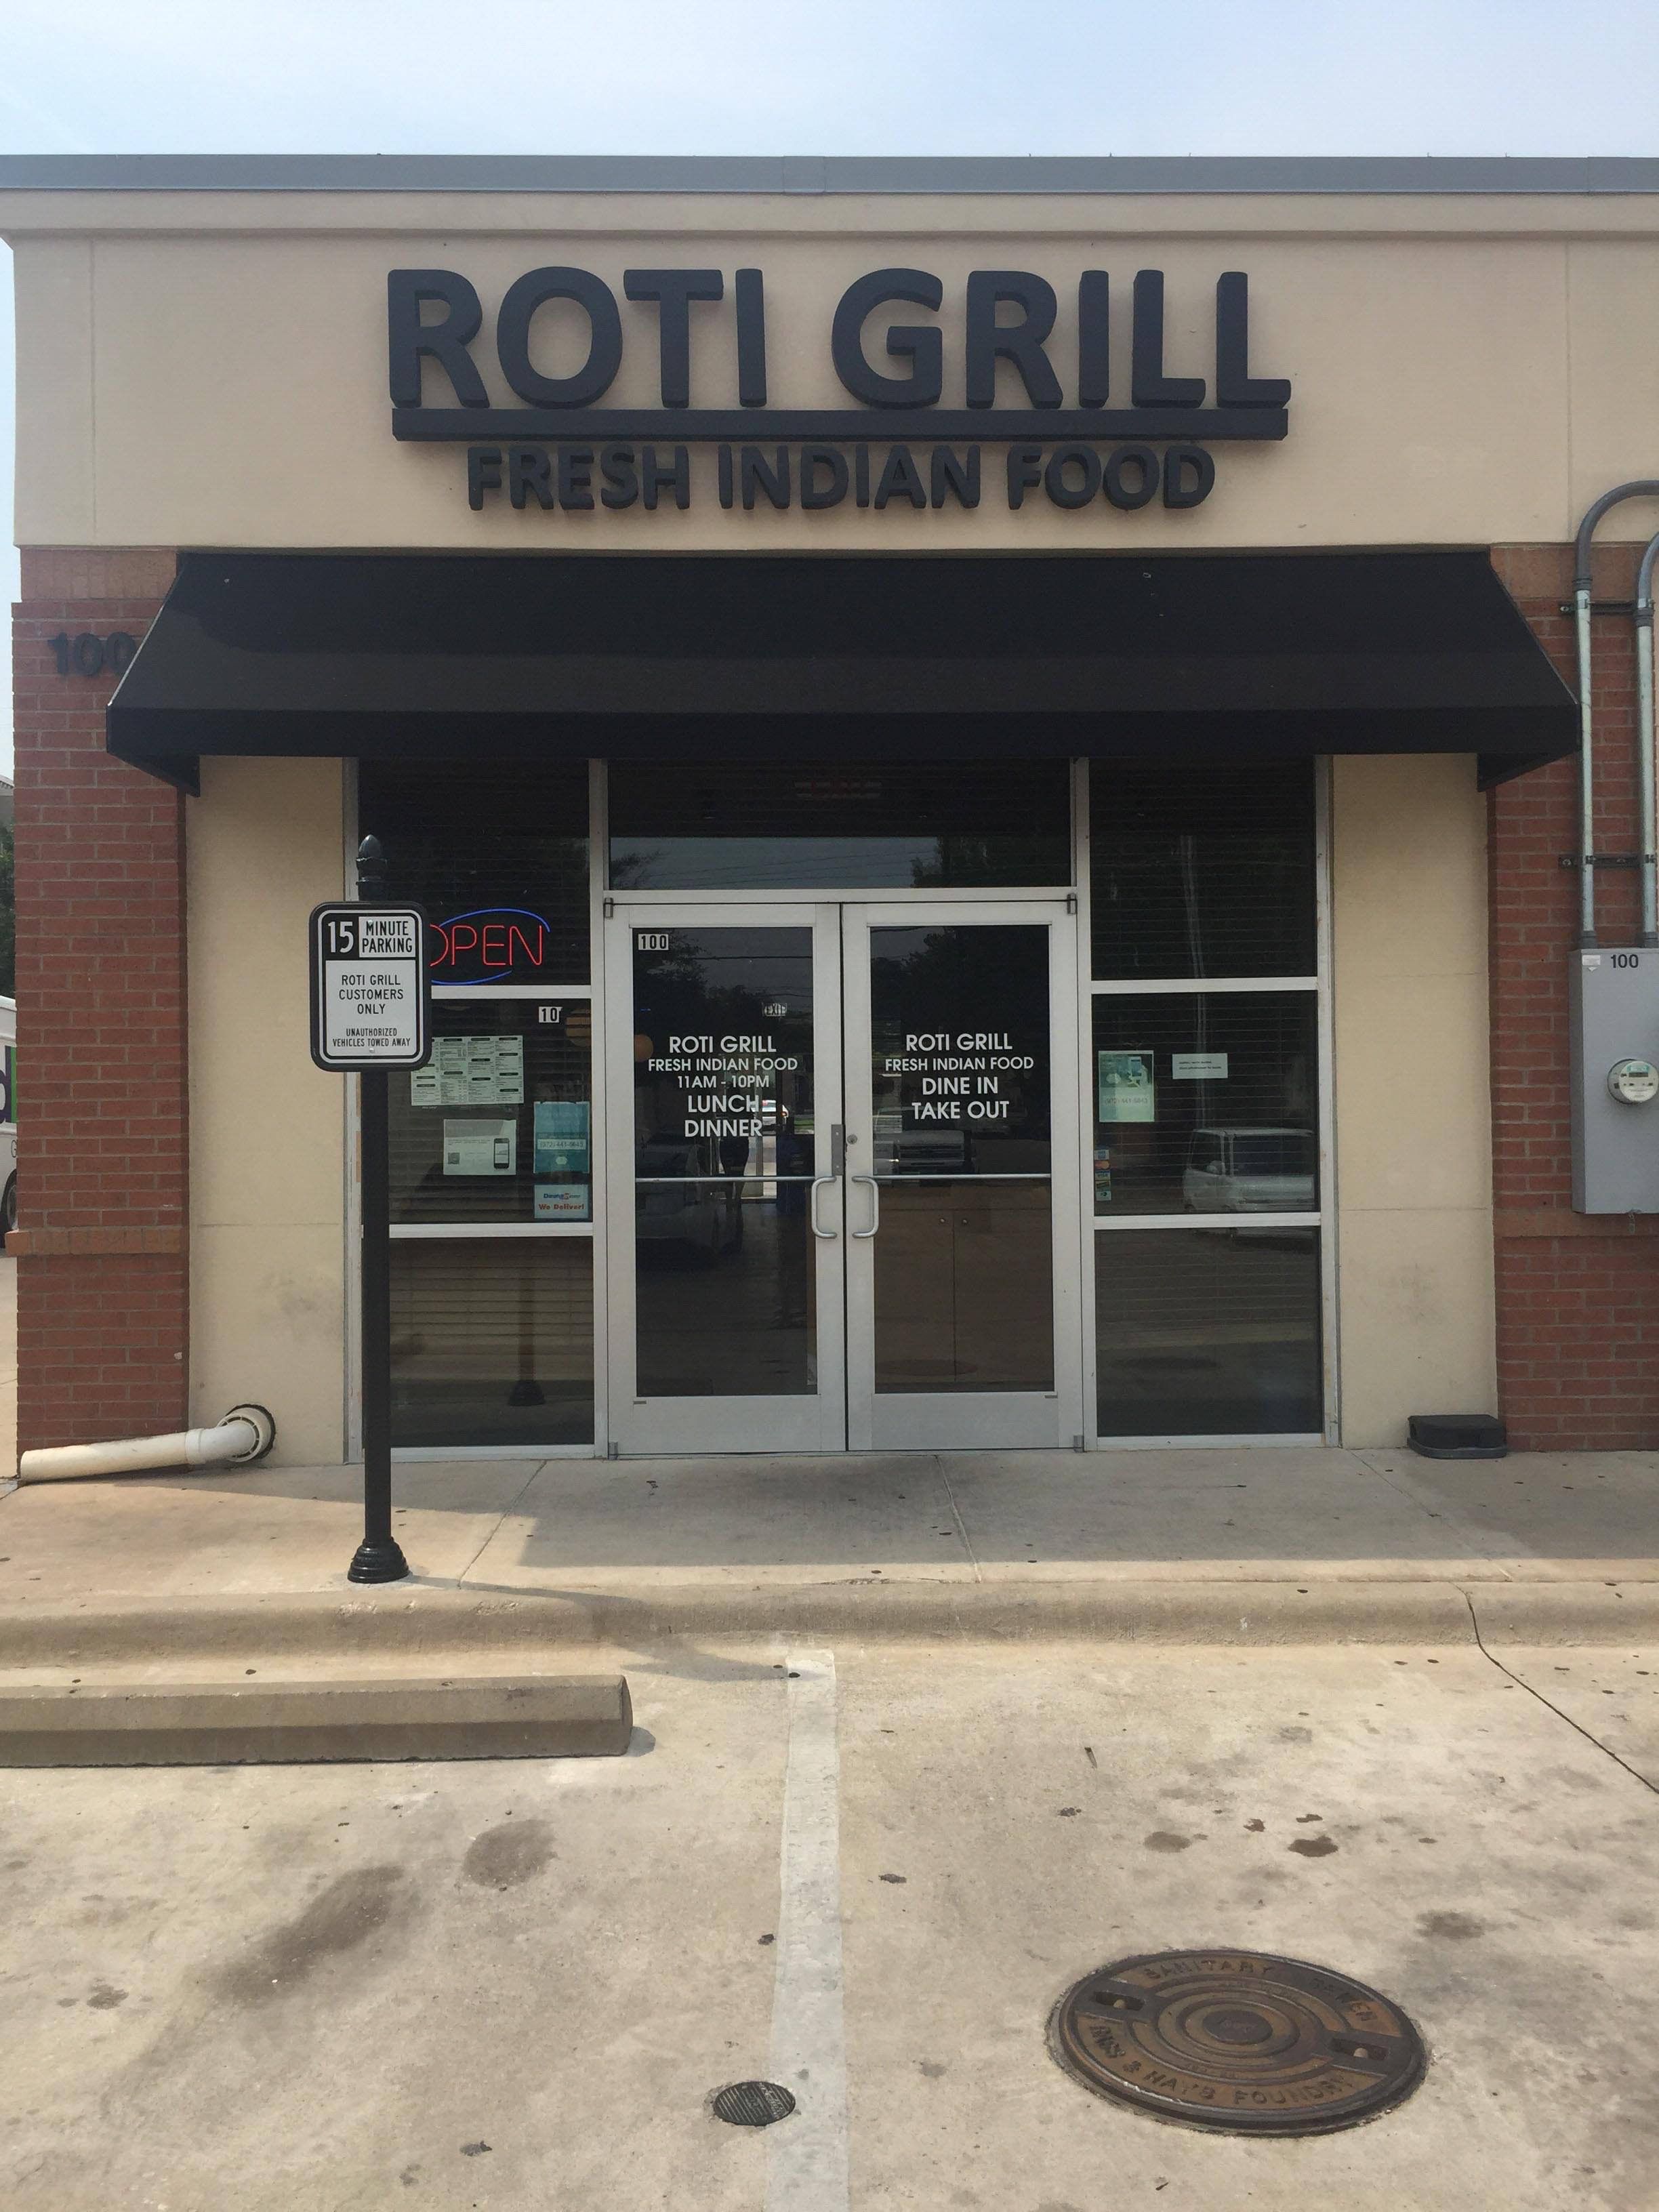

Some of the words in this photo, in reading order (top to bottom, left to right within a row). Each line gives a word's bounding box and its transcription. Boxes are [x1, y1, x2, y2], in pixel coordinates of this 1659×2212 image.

[387, 266, 768, 409] ROTI
[831, 268, 1291, 409] GRILL
[468, 444, 690, 512] FRESH
[718, 443, 981, 511] INDIAN
[1007, 444, 1217, 512] FOOD
[47, 632, 136, 676] 100
[366, 920, 409, 936] MINUTE
[328, 921, 354, 954] 15
[362, 937, 413, 954] PARKING
[641, 935, 667, 949] 100
[1610, 954, 1639, 968] 100
[342, 975, 365, 986] ROTI
[370, 975, 401, 985] GRILL
[339, 989, 404, 1000] CUSTOMERS
[357, 1004, 386, 1015] ONLY
[346, 1027, 397, 1037] UNAUTHORIZED
[333, 1038, 365, 1047] VEHICLES
[367, 1038, 390, 1047] TOWED
[392, 1038, 411, 1047] AWAY
[669, 1036, 714, 1053] ROTI
[720, 1035, 777, 1053] GRILL
[906, 1033, 949, 1051] ROTI
[956, 1033, 1013, 1051] GRILL
[648, 1058, 691, 1072] FRESH
[696, 1058, 750, 1071] INDIAN
[754, 1057, 798, 1071] FOOD
[885, 1058, 928, 1071] FRESH
[933, 1057, 985, 1071] INDIAN
[990, 1057, 1034, 1070] FOOD
[677, 1076, 716, 1089] 11AM
[731, 1075, 770, 1088] 10PM
[922, 1077, 970, 1095] DINE
[977, 1076, 998, 1094] IN
[688, 1094, 760, 1113] LUNCH
[912, 1101, 960, 1120] TAKE
[967, 1101, 1010, 1119] OUT
[684, 1119, 763, 1137] DINNER
